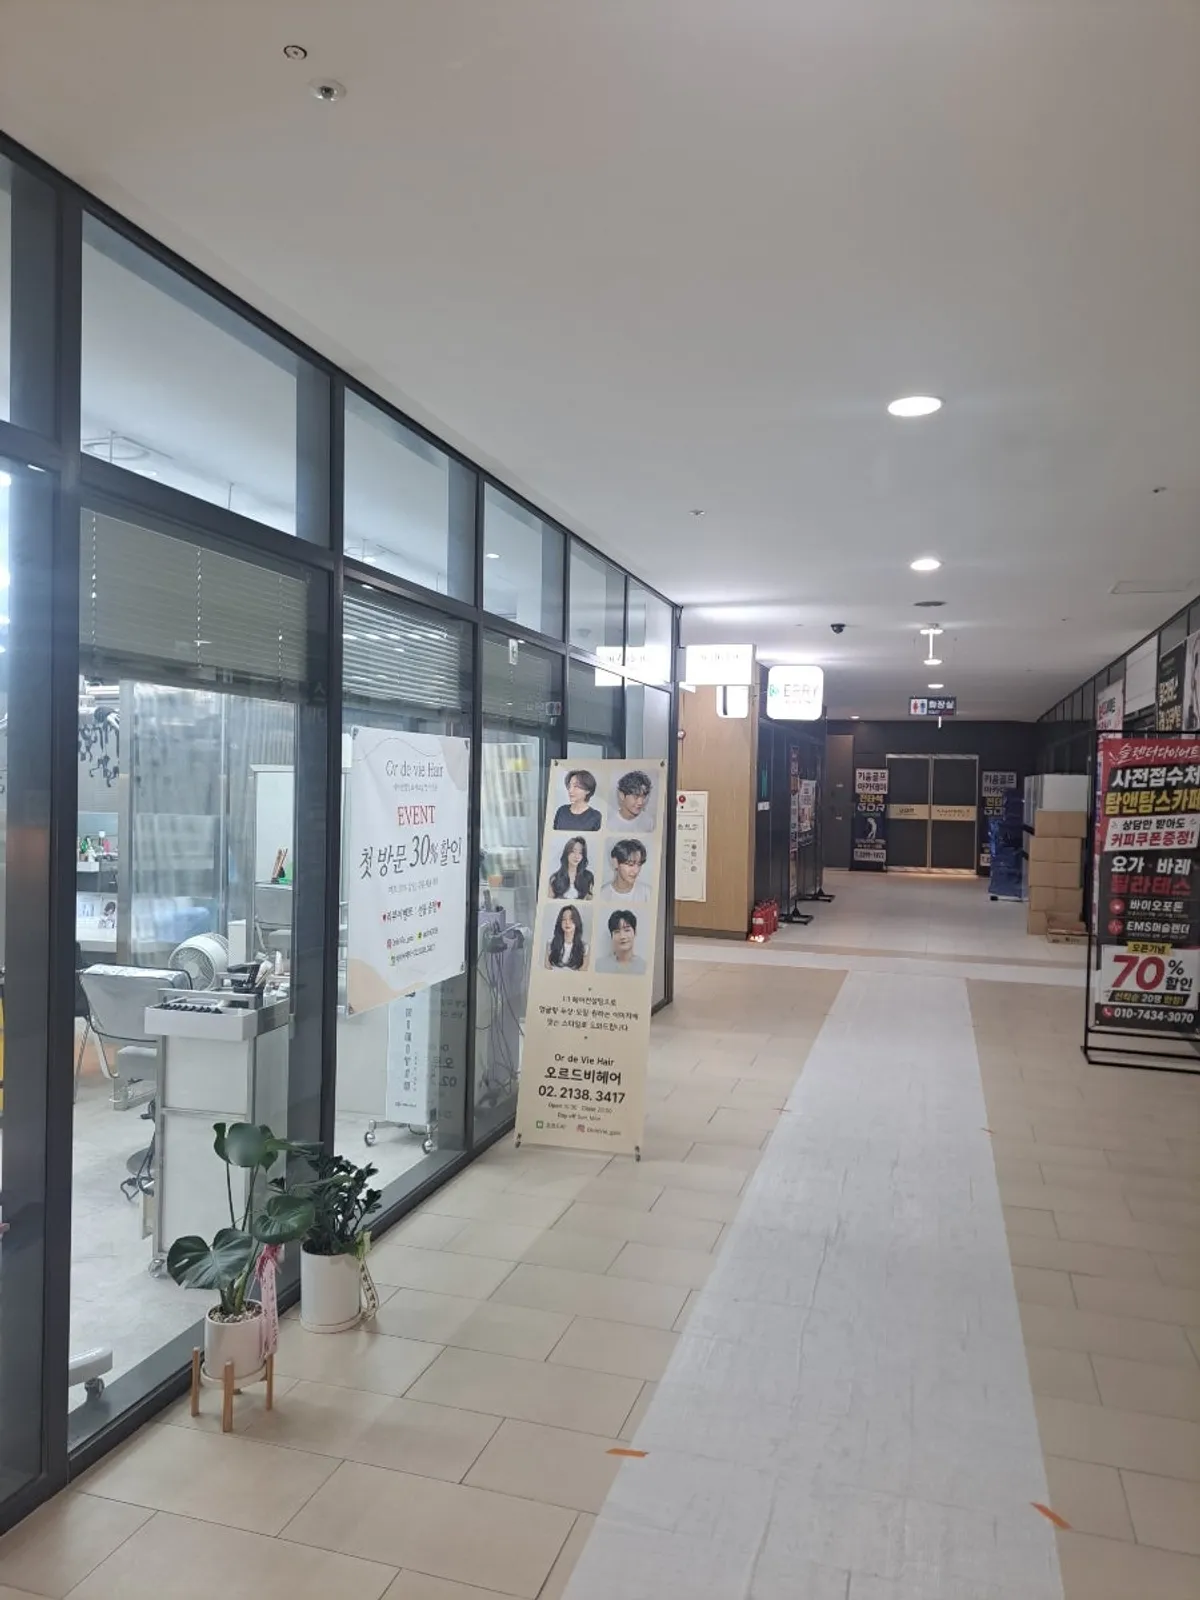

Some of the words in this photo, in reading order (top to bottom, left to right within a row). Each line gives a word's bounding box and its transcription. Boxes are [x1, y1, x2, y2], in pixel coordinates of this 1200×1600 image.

[397, 805, 436, 826] EVENT
[1111, 830, 1194, 847] 커피쿠폰증정!
[360, 846, 373, 879] 첫
[378, 845, 407, 877] 방문
[1111, 856, 1145, 873] 요가
[1157, 858, 1192, 875] 바레
[1111, 874, 1192, 896] 필라테스
[1132, 943, 1166, 954] 오픈기념
[1166, 976, 1193, 991] 할인
[1142, 993, 1163, 1004] 20명
[1114, 1007, 1194, 1023] 010-7434-3070
[554, 1053, 565, 1061] Or
[567, 1055, 578, 1063] de
[581, 1056, 594, 1065] Vie
[597, 1057, 615, 1066] Hair
[544, 1066, 622, 1086] 오르드비헤어
